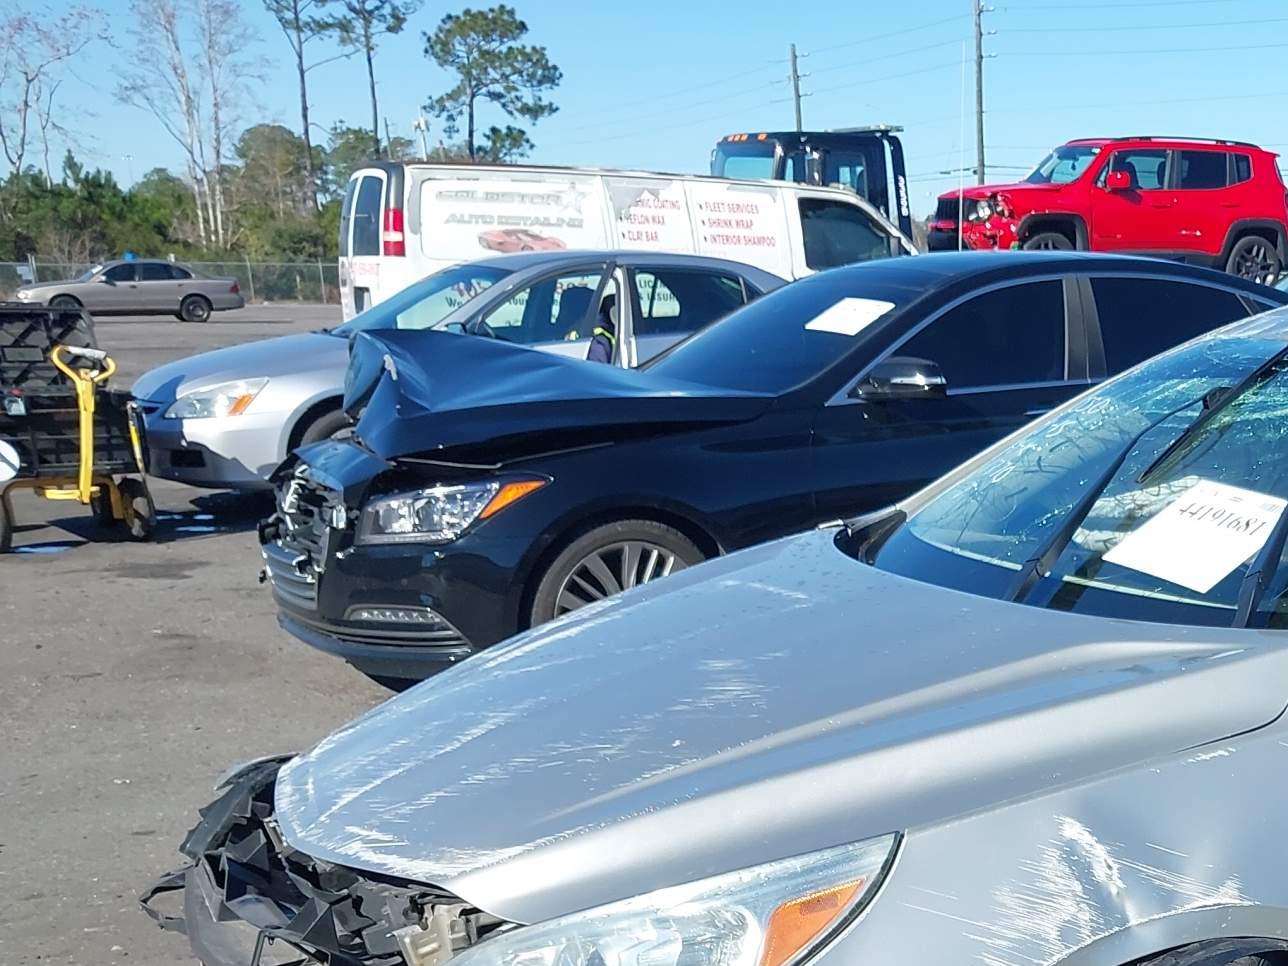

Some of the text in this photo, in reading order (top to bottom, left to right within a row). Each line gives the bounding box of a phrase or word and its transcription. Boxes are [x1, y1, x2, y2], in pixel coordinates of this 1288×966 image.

[704, 201, 760, 215] FLEET SERVICES
[444, 213, 584, 229] AUTO DETAILING
[707, 217, 754, 230] SHRINK WRAP
[627, 230, 660, 242] CLAY BAR
[709, 233, 777, 247] INTERIOR SHAMPOO
